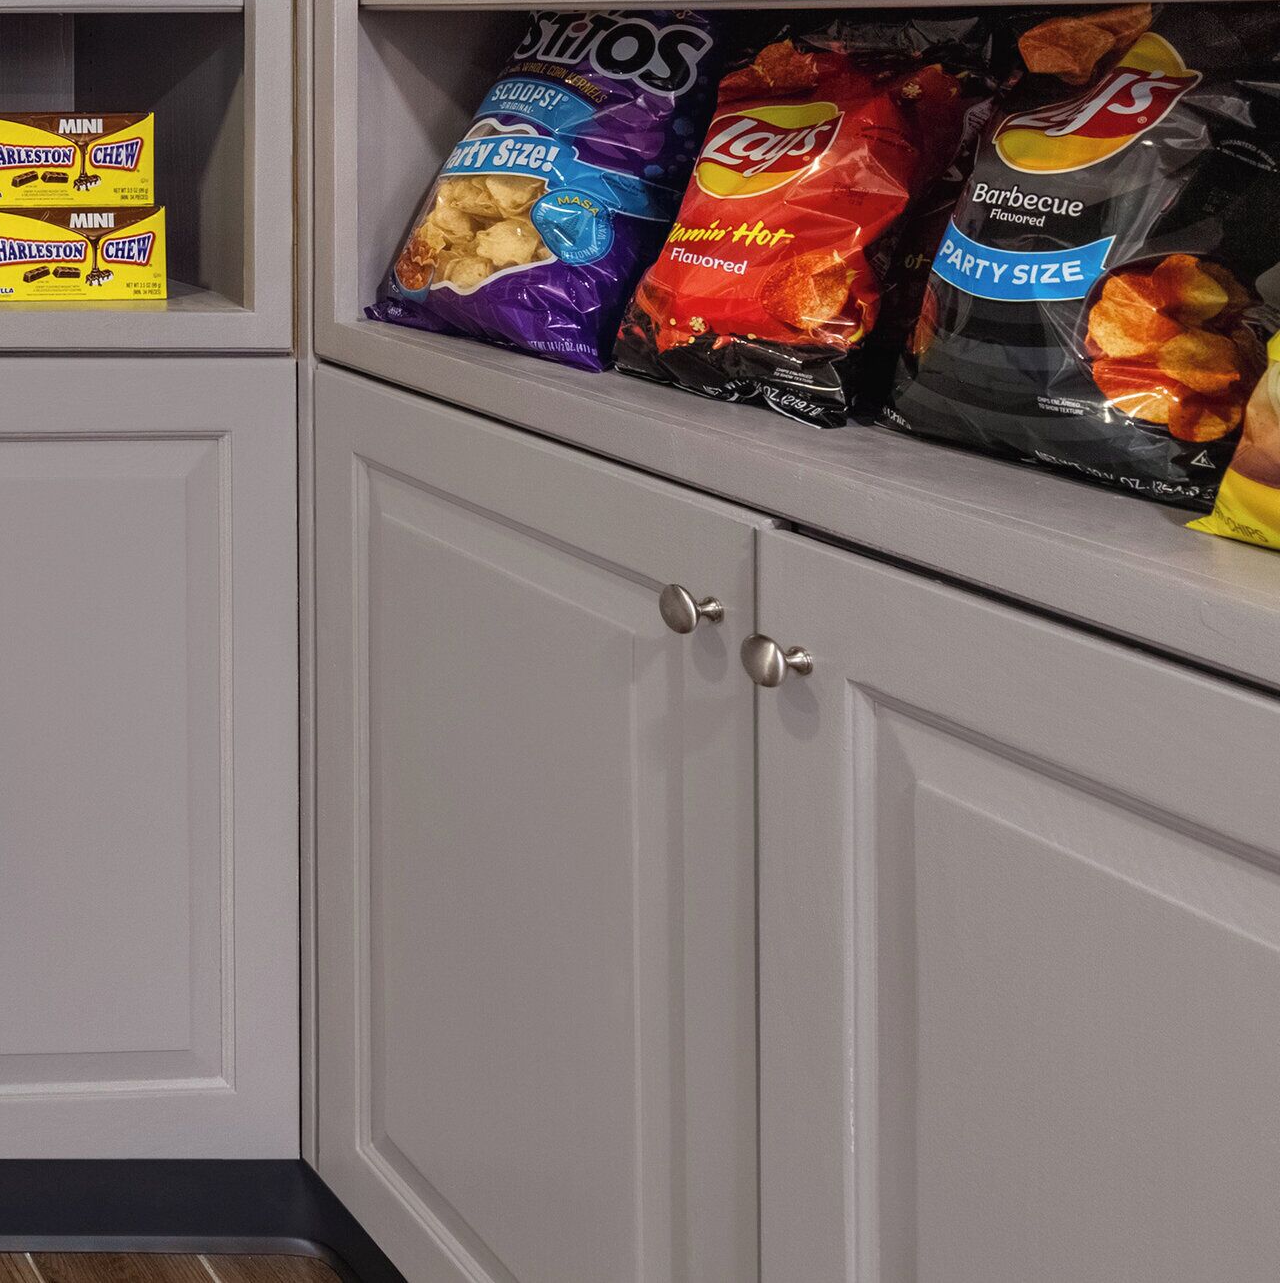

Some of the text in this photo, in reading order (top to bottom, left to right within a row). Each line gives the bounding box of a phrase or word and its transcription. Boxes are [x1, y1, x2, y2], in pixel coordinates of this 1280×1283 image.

[491, 85, 562, 110] SCOOPS!
[58, 119, 103, 134] MINI
[91, 139, 141, 169] CHEW
[493, 139, 560, 172] Size!
[702, 119, 831, 177] Lay's
[557, 195, 599, 216] MASA
[972, 183, 1084, 217] Barbecue
[70, 213, 114, 228] MINI
[990, 209, 1045, 227] Flavored
[103, 233, 153, 263] CHEW
[733, 223, 794, 246] Hot
[670, 248, 748, 275] Flavored
[939, 239, 1084, 285] PARTY SIZE
